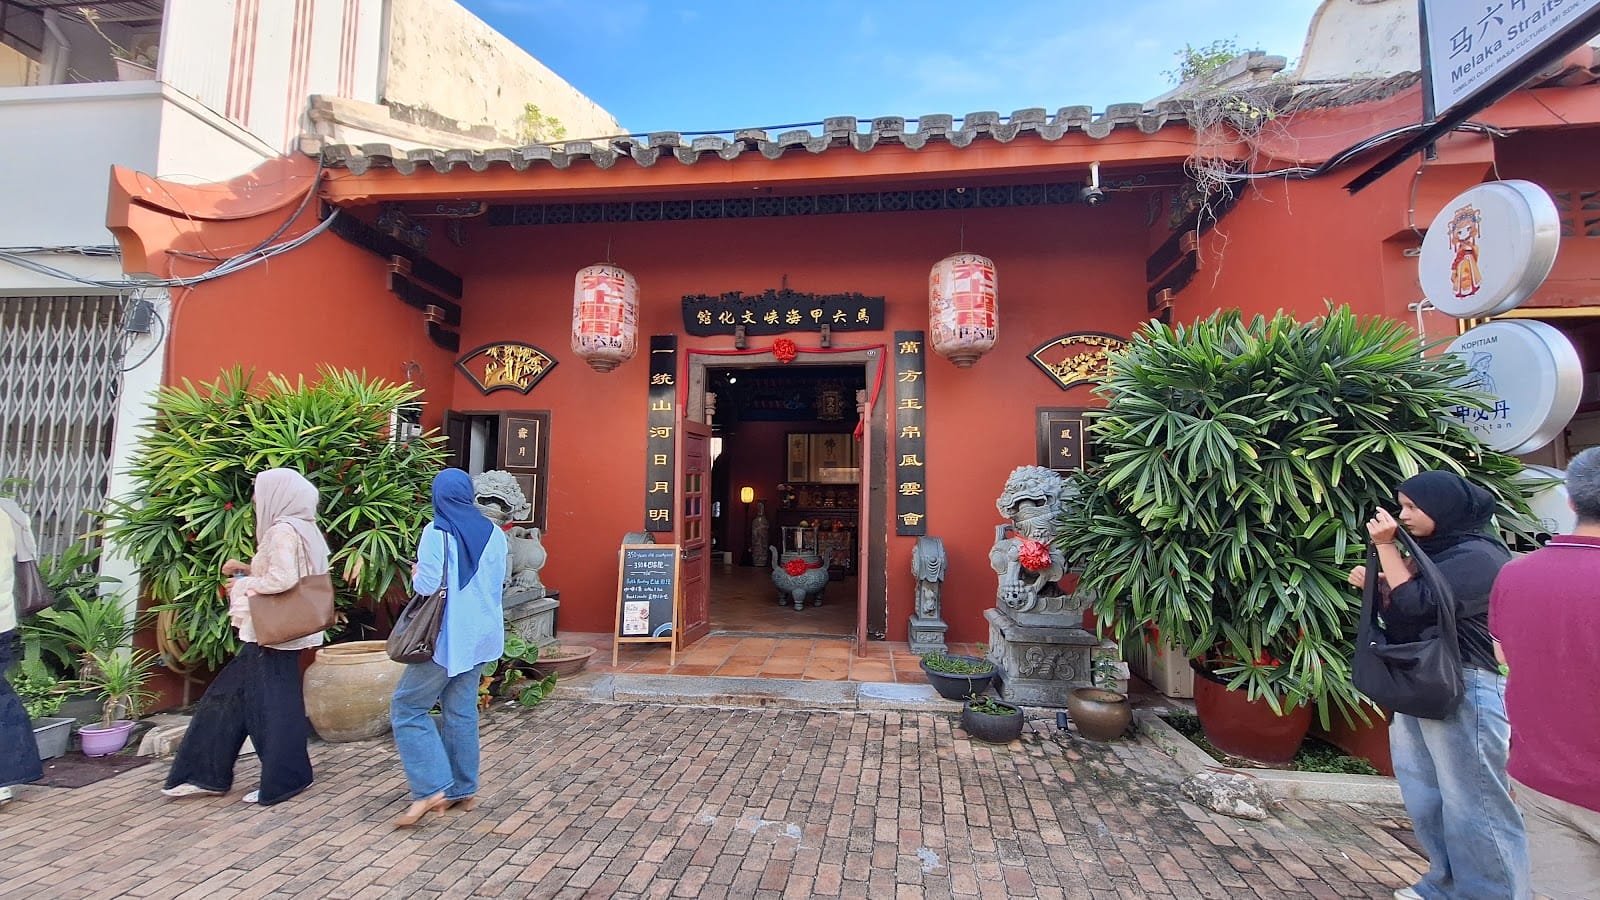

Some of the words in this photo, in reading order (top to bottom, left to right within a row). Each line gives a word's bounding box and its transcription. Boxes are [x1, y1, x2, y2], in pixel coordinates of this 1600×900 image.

[1451, 40, 1502, 83] Melaka
[1507, 0, 1561, 41] Straits
[1496, 48, 1515, 63] MASA
[1516, 25, 1548, 49] CULTURE
[697, 308, 870, 325] 馬六甲海峽文化館
[1461, 336, 1498, 351] KOPITIAM
[649, 349, 675, 522] 一統山河日月明
[898, 341, 924, 526] 萬方玉帛風雲會
[1467, 422, 1512, 432] pitan
